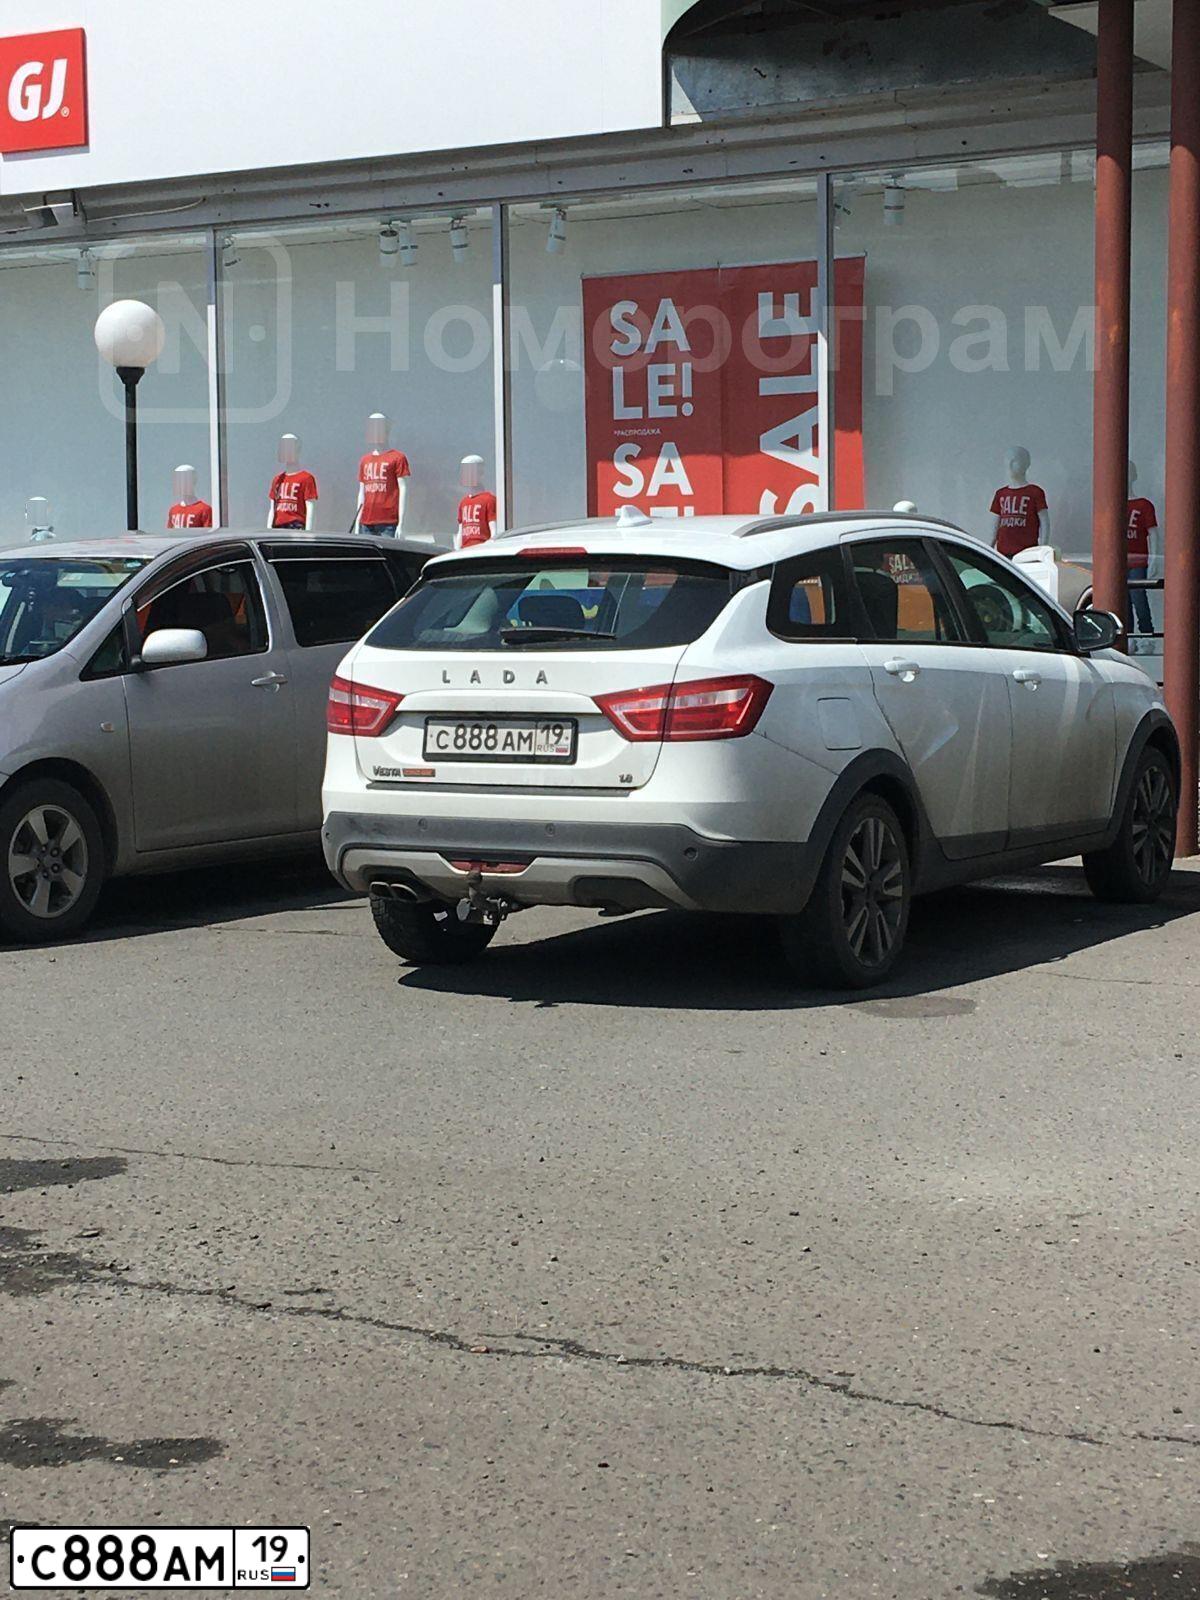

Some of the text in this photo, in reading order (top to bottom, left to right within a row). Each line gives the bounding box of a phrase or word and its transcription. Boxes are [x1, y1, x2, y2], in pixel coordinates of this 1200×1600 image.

[609, 298, 692, 356] SA
[612, 362, 694, 420] LE!
[612, 442, 694, 498] SA
[442, 670, 548, 684] LADA
[541, 723, 564, 746] 19
